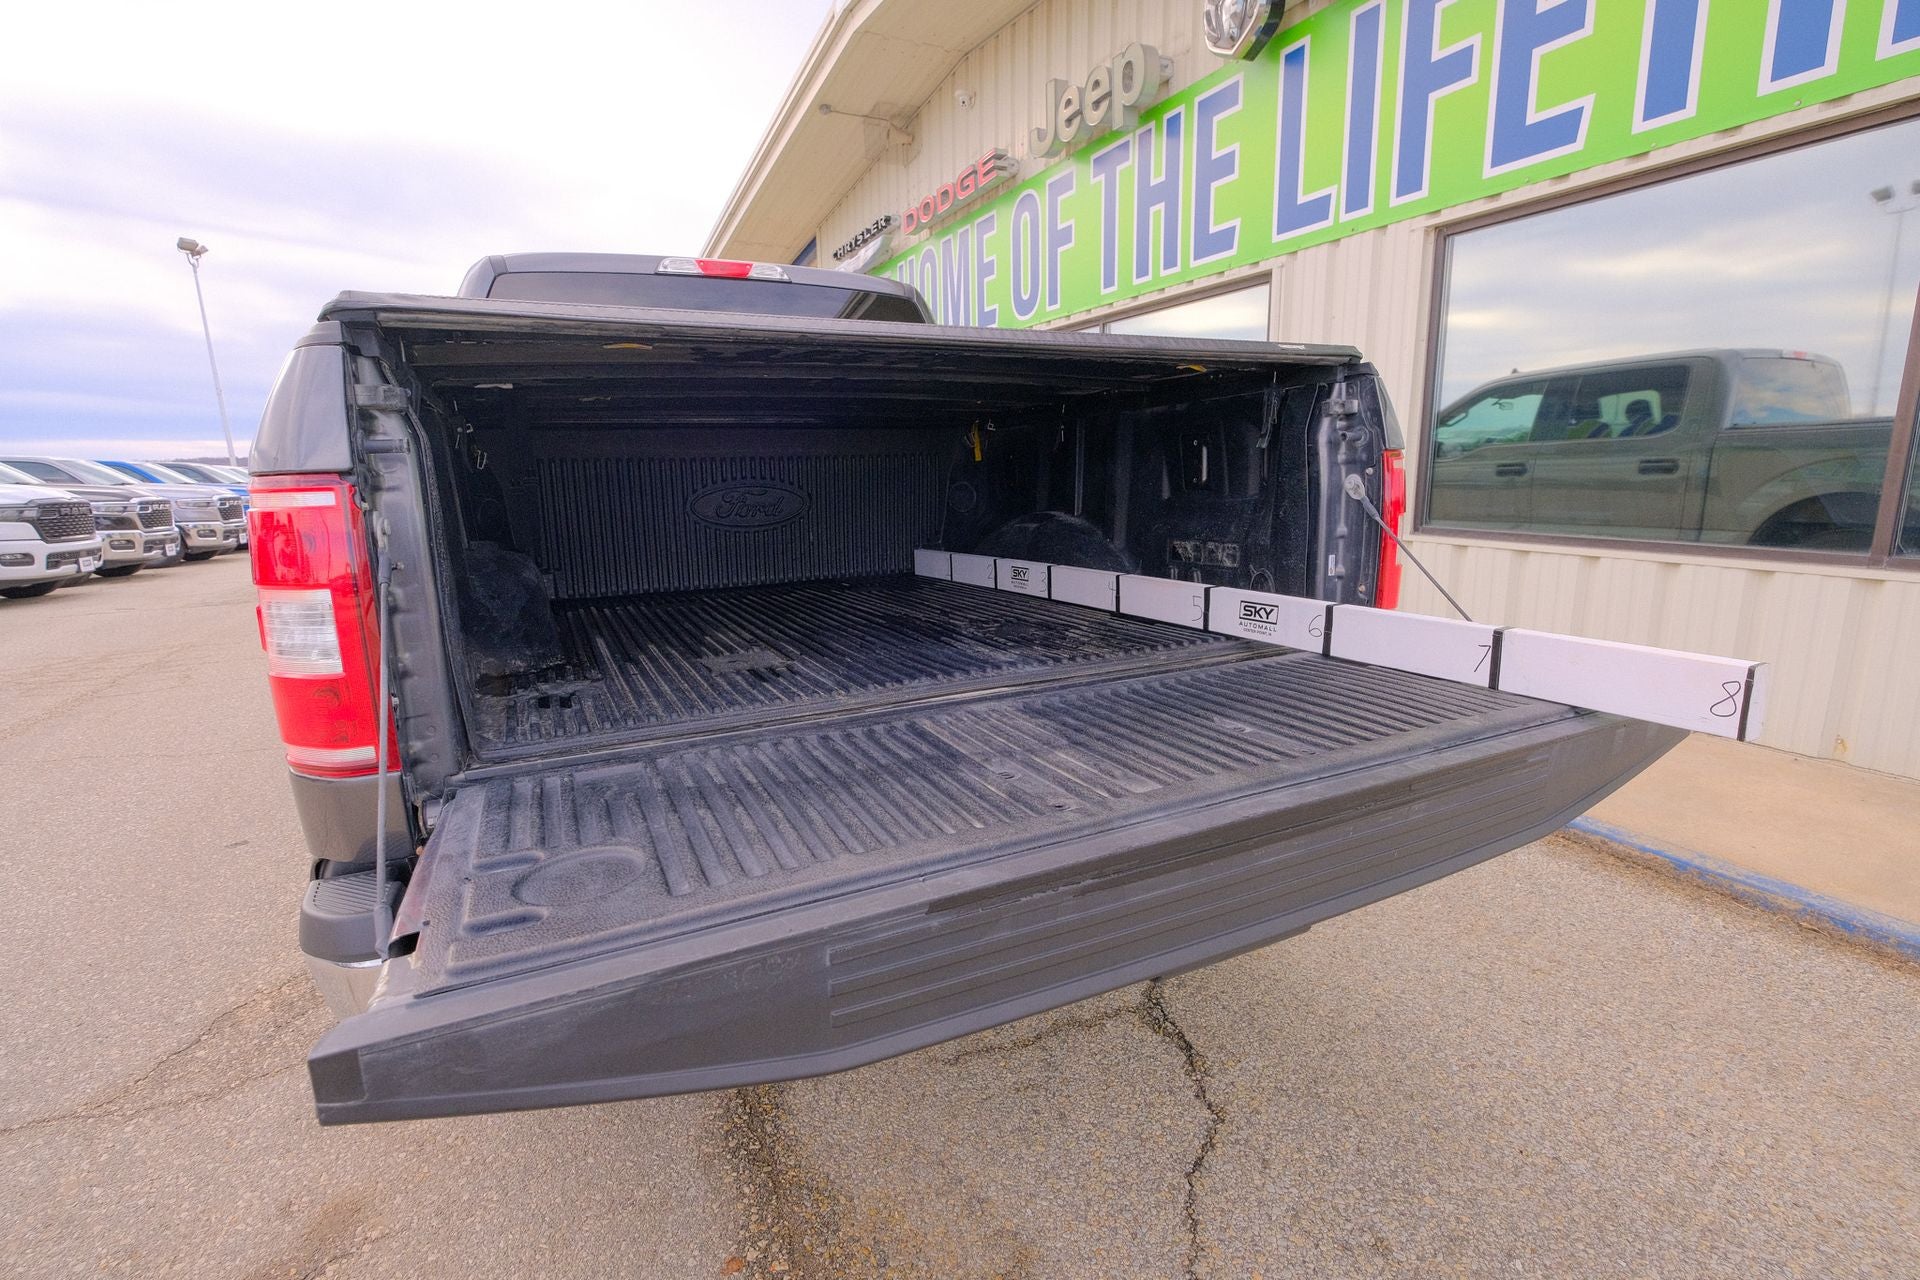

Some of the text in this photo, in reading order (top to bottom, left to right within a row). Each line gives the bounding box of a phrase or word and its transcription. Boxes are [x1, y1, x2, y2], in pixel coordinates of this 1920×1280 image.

[1030, 41, 1150, 159] Jeep
[902, 147, 999, 235] DODGE
[1010, 167, 1075, 321] OF
[1090, 72, 1243, 296] THE
[715, 488, 785, 518] Ford
[1012, 569, 1028, 579] SKY
[1040, 571, 1047, 593] 3
[1108, 579, 1116, 606] 4
[1192, 595, 1203, 622] 5
[1242, 604, 1275, 620] SKY
[1239, 621, 1277, 632] AUTOMALL
[1308, 614, 1323, 638] 6
[1474, 644, 1492, 673] 7
[1709, 681, 1741, 717] 8
